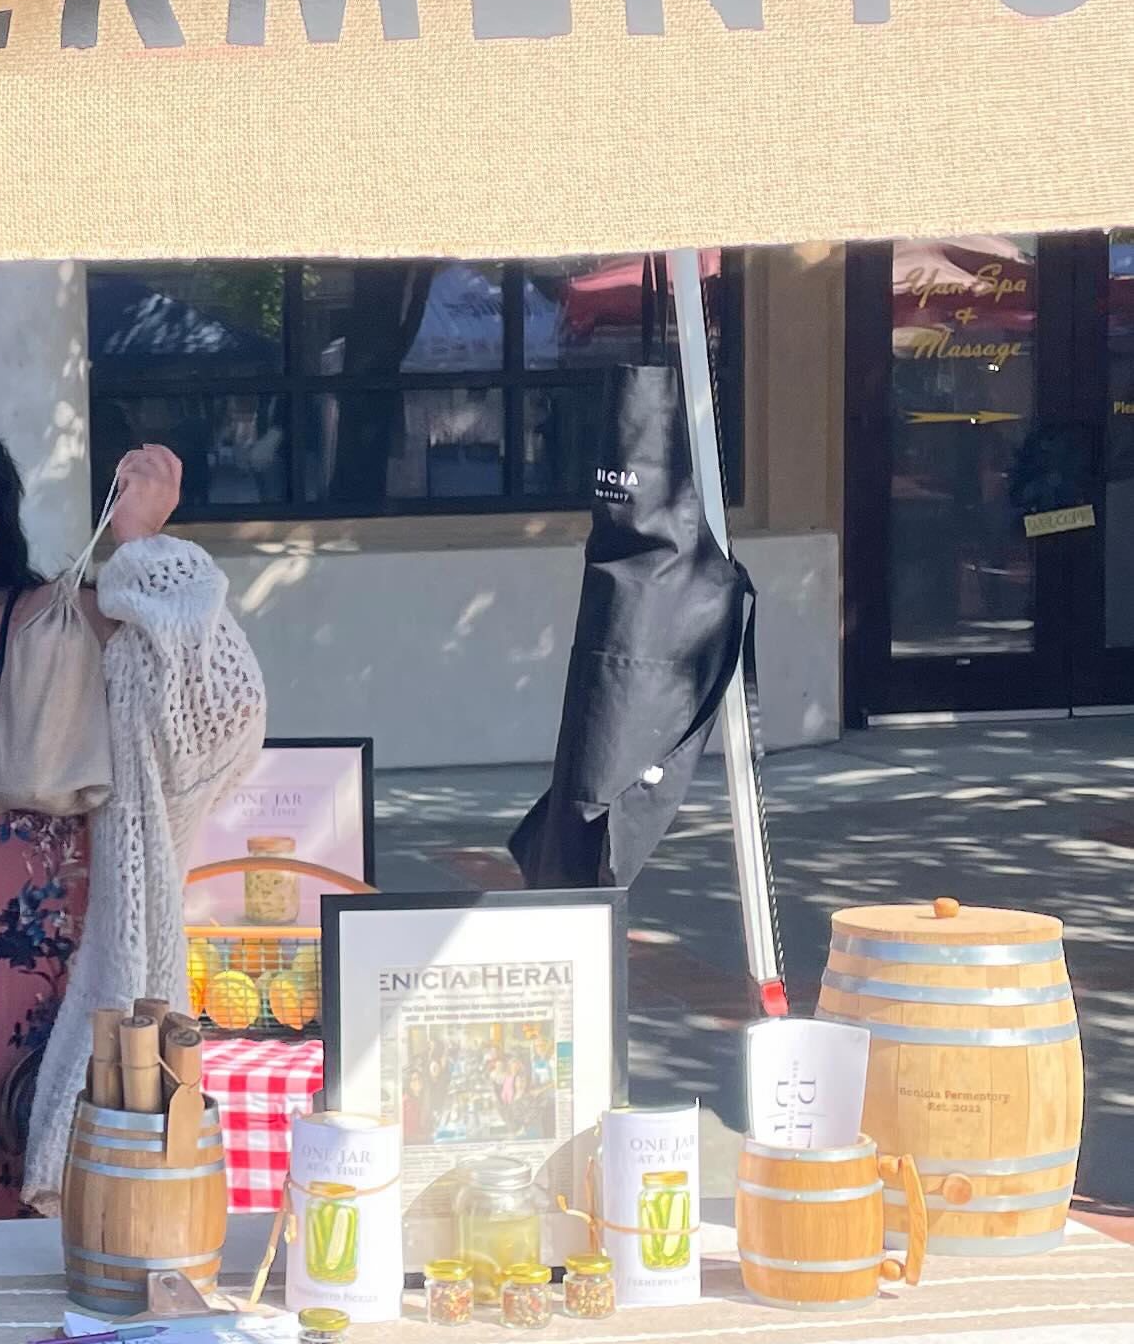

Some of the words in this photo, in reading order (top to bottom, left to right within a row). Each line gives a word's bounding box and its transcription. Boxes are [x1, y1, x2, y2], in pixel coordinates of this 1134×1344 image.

[973, 263, 1026, 303] Spa
[913, 328, 1022, 366] Massage
[273, 792, 303, 808] JAR
[301, 1143, 334, 1162] ONE
[340, 1150, 371, 1164] JAR
[630, 1137, 669, 1153] ONE
